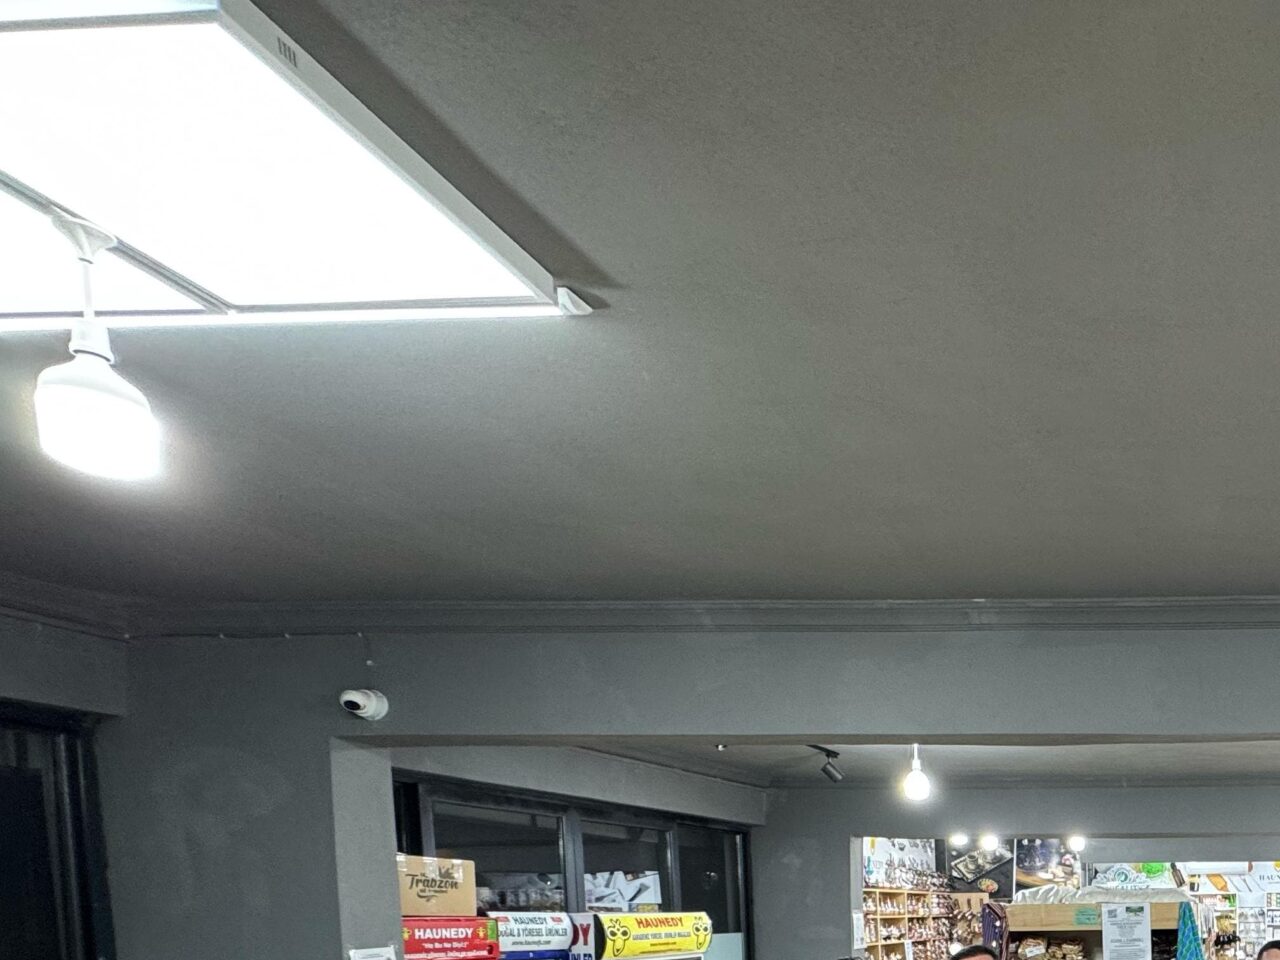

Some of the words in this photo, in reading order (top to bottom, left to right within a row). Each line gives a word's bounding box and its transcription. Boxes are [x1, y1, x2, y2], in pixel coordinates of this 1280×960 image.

[405, 873, 459, 889] Trabzon
[512, 916, 548, 925] HAUNEDY
[635, 917, 684, 928] HAUNEDY
[414, 928, 474, 940] HAUNEDY
